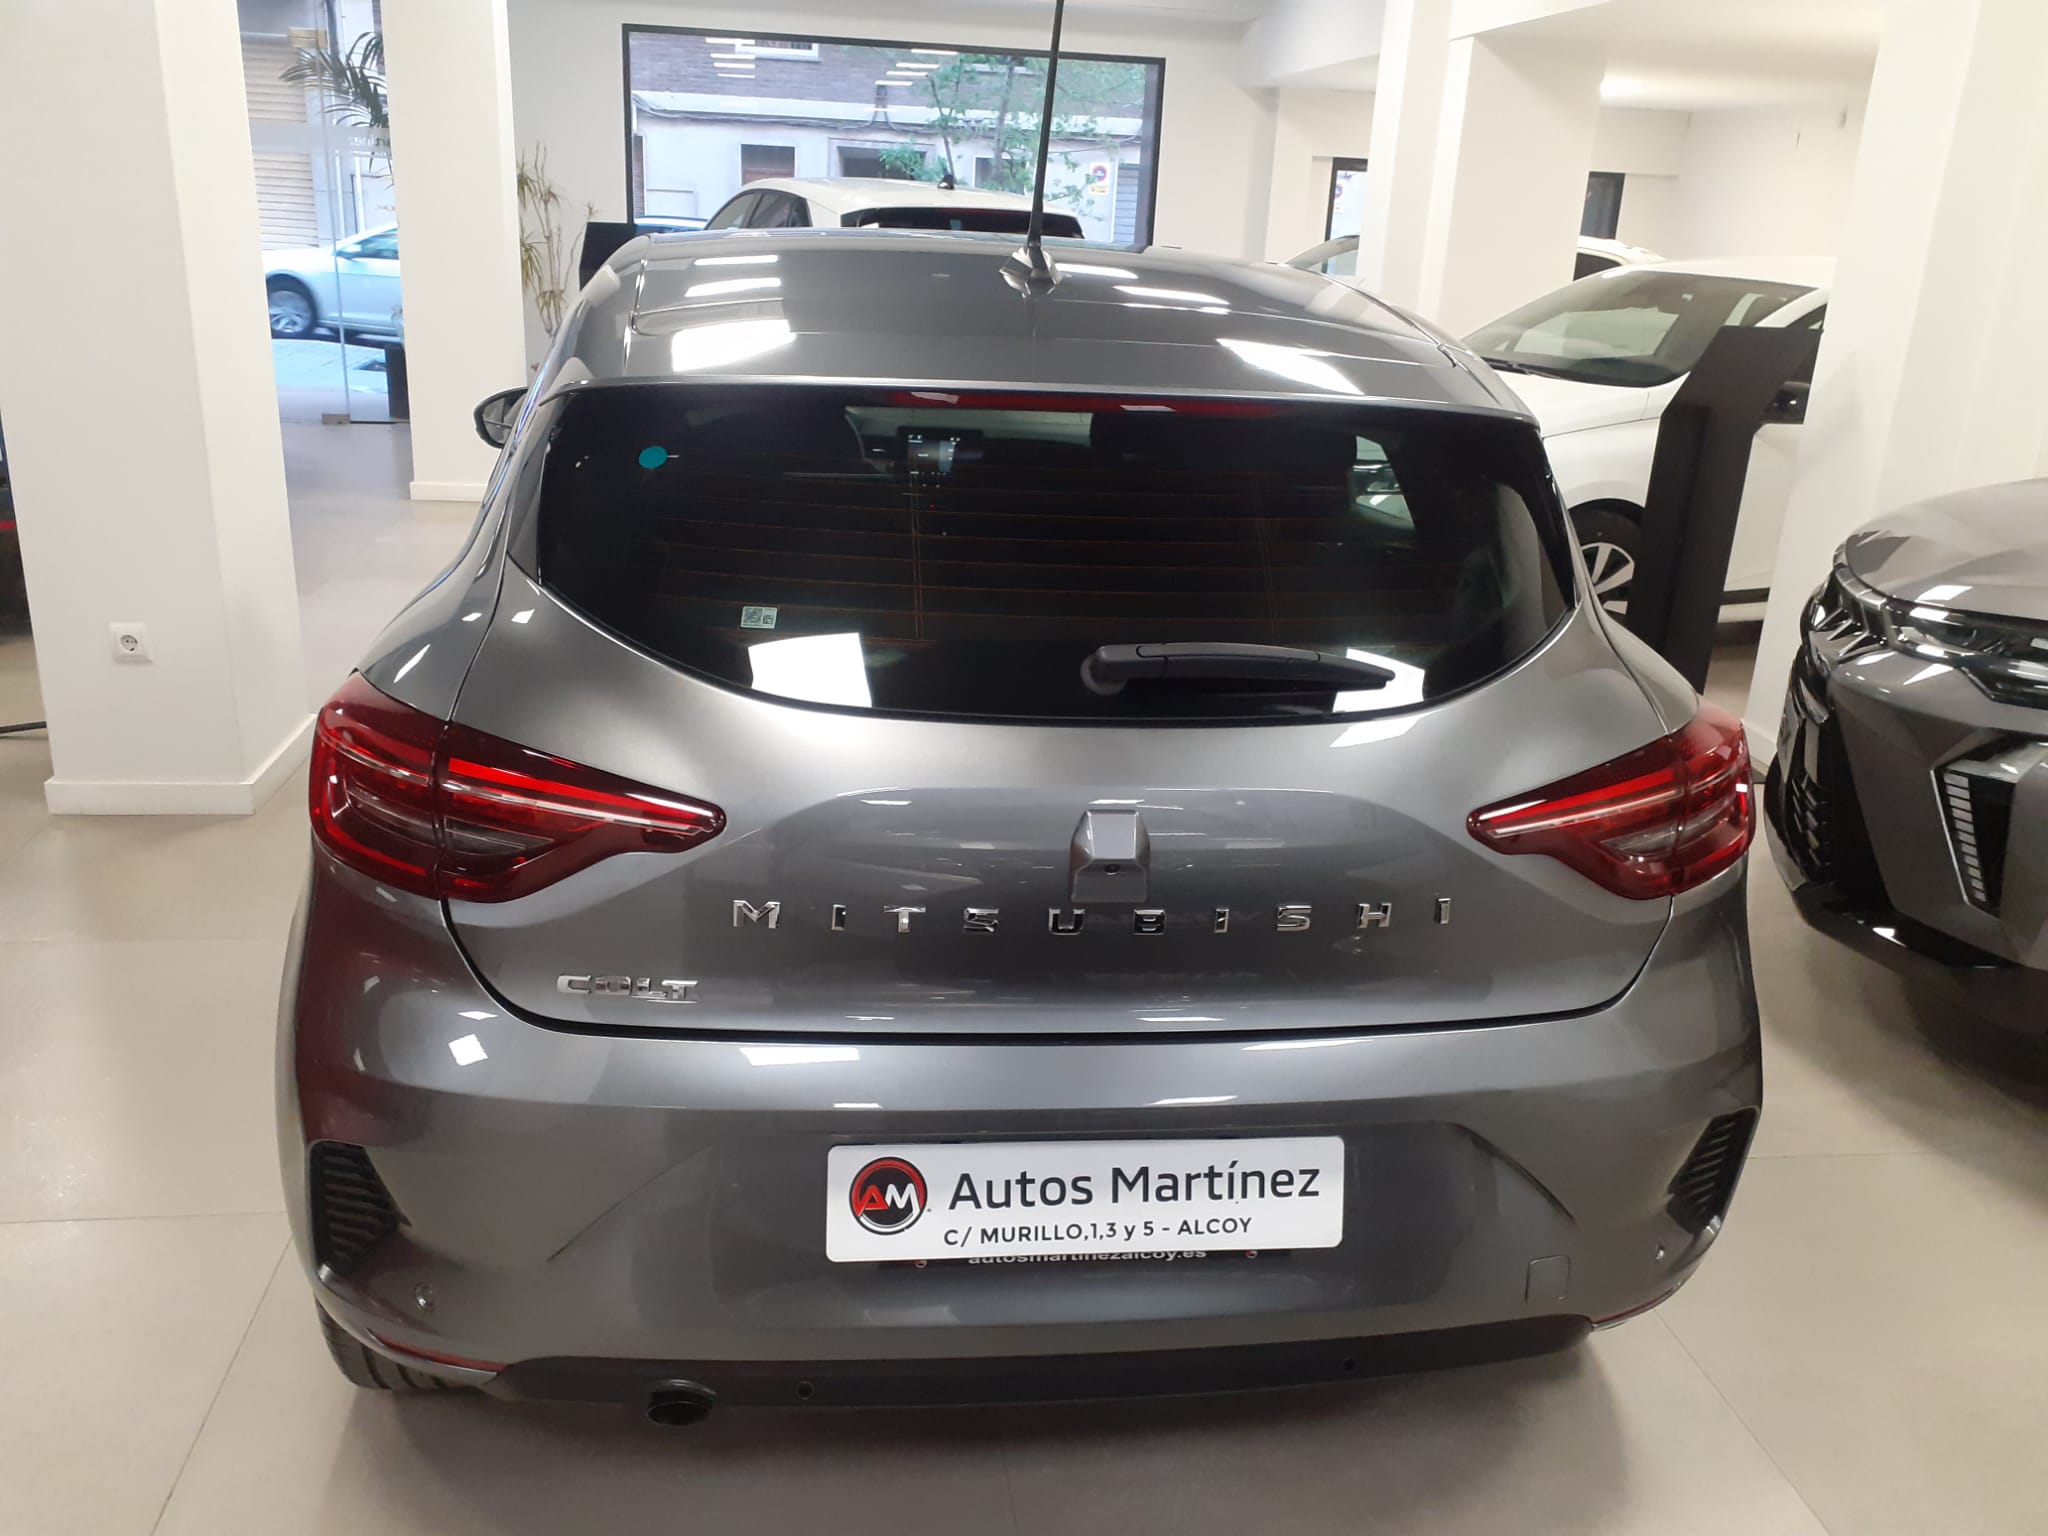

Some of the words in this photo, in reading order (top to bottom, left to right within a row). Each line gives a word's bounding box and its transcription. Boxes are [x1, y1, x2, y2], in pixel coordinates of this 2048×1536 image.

[731, 896, 1452, 936] MITSUBISHI
[556, 973, 699, 1001] COLT
[947, 1170, 1094, 1211] Autos
[1110, 1159, 1321, 1204] Martínez
[943, 1226, 973, 1248] C/
[1123, 1223, 1137, 1242] y
[1143, 1220, 1155, 1237] 5
[1176, 1216, 1253, 1236] ALCOY
